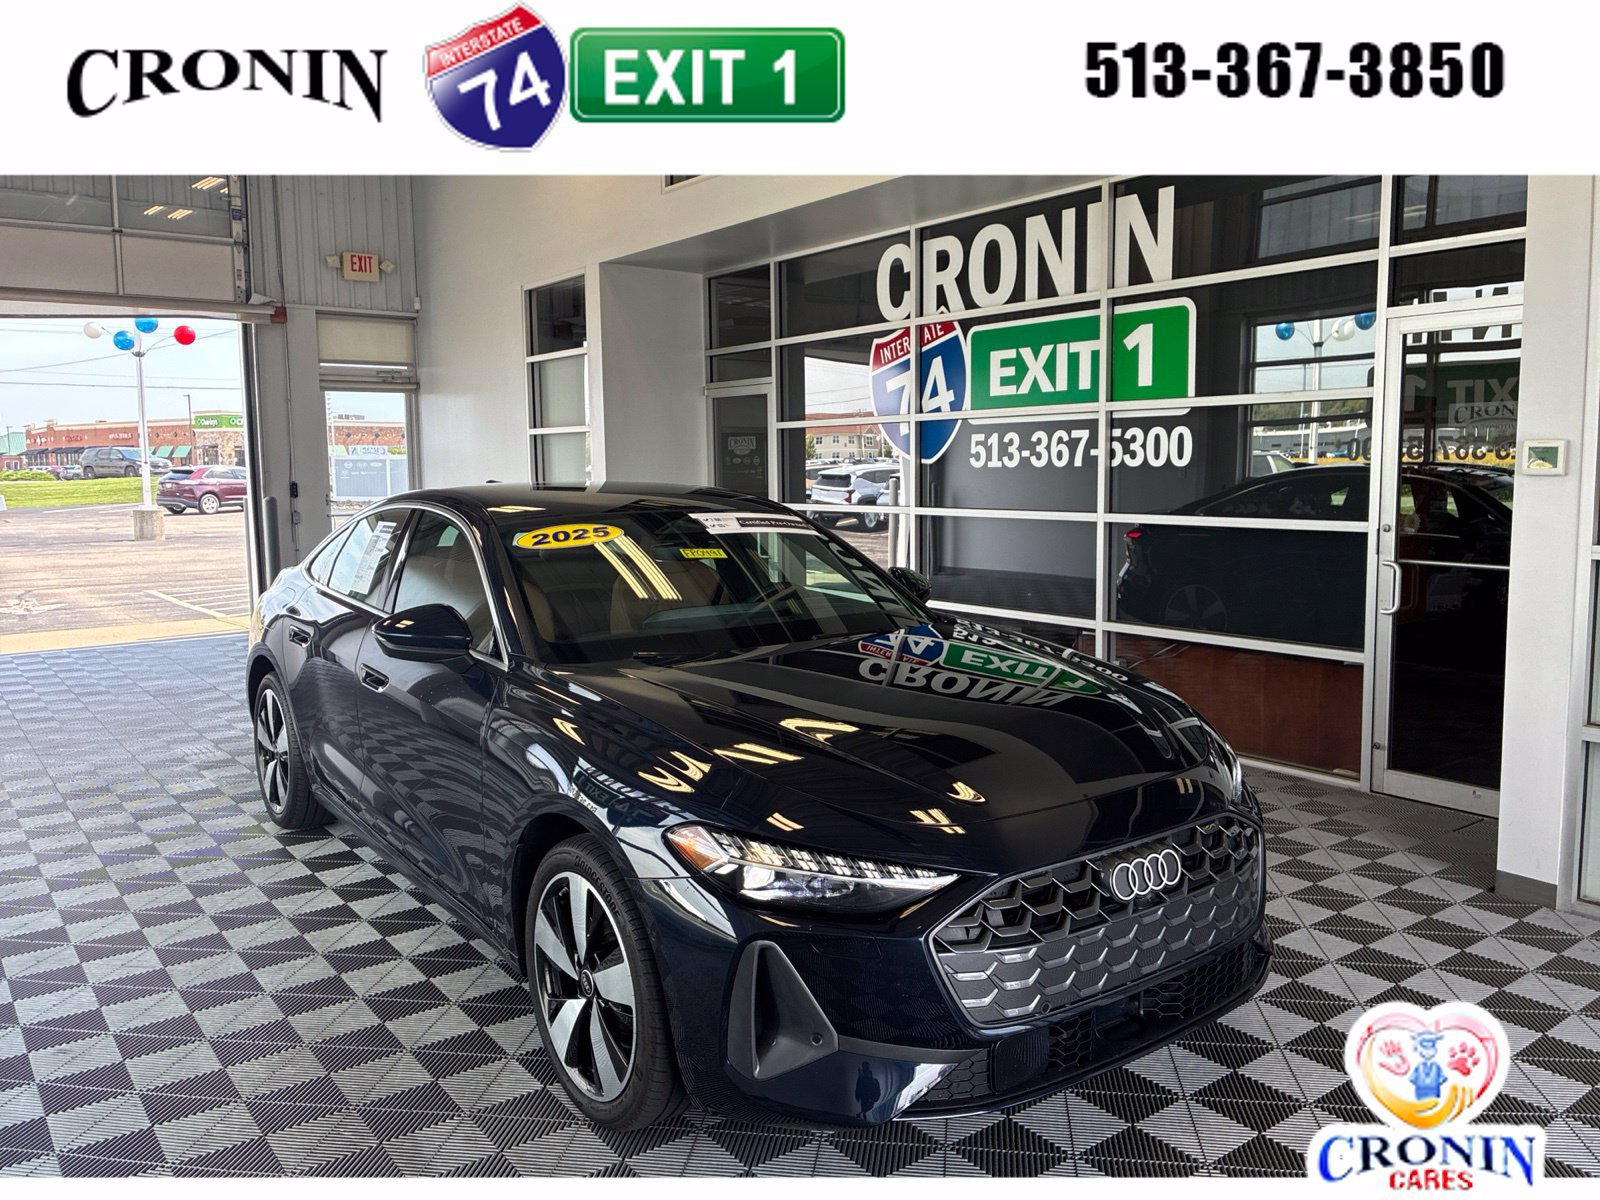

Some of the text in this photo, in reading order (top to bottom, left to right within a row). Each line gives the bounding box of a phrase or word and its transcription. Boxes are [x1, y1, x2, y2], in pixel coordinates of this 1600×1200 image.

[350, 254, 374, 274] EXIT
[876, 184, 1176, 323] CRONIN
[879, 323, 945, 365] INTERATE
[989, 322, 1154, 397] EXIT 1
[886, 355, 956, 436] 74
[968, 425, 1194, 469] 513-367-5300
[531, 526, 611, 547] 2025
[574, 855, 621, 918] BRIDGESTONE
